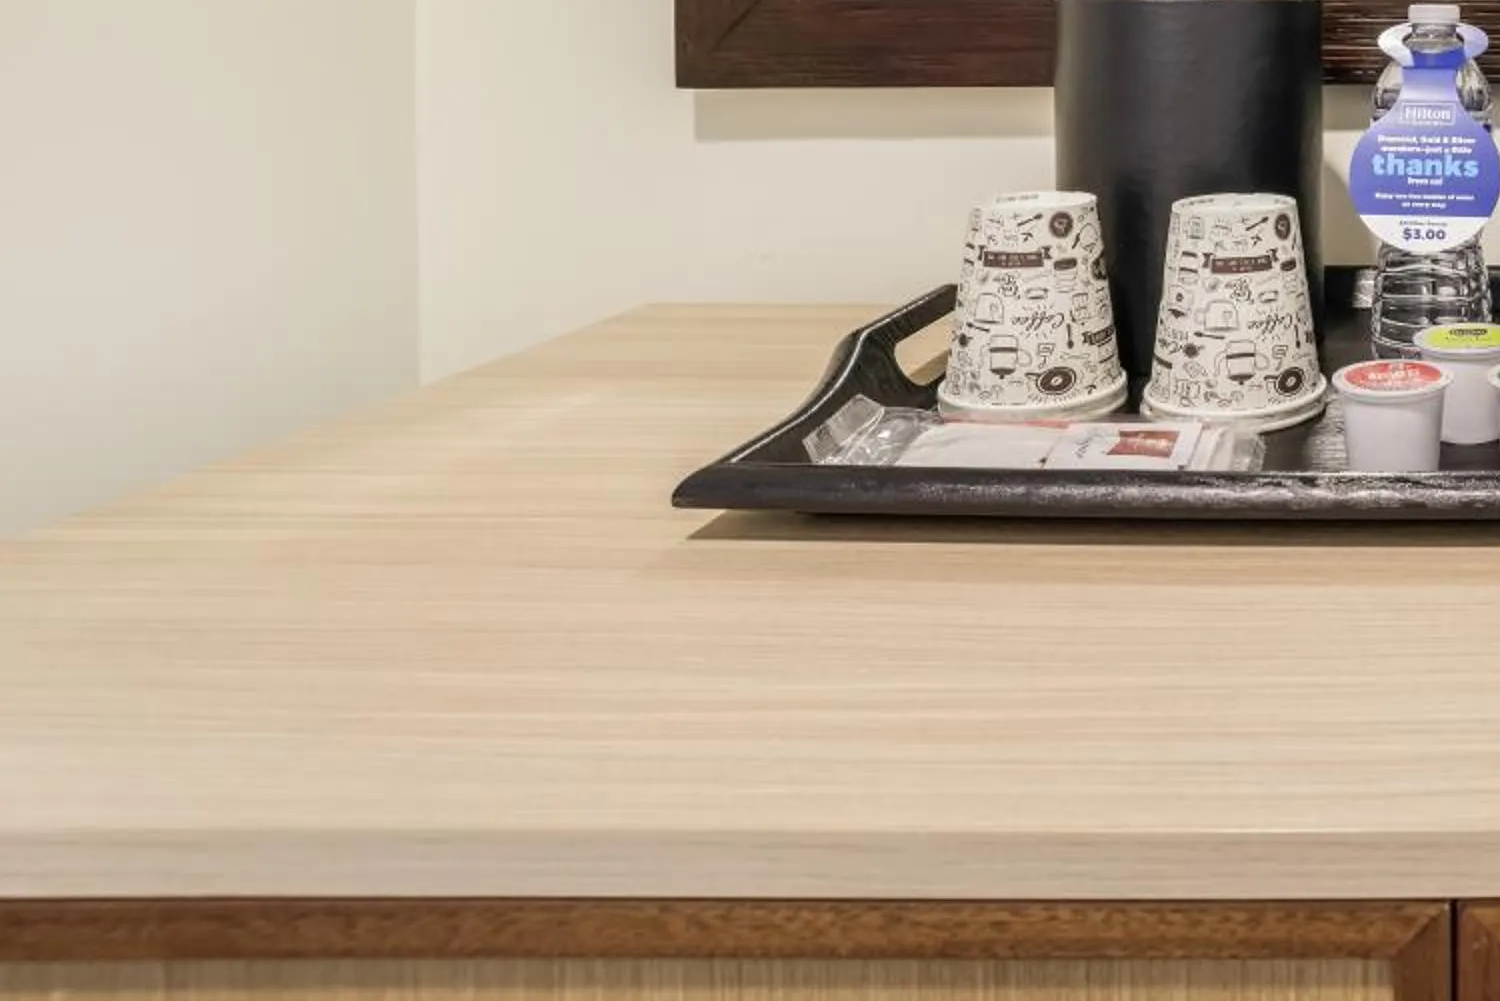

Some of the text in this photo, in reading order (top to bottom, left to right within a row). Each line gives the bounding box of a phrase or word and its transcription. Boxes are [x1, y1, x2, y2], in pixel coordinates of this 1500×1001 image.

[1405, 106, 1451, 120] Hilton
[1372, 152, 1480, 178] thanks
[1402, 227, 1447, 242] $3.00
[1011, 311, 1065, 331] Coffee
[1248, 313, 1294, 334] Coffee
